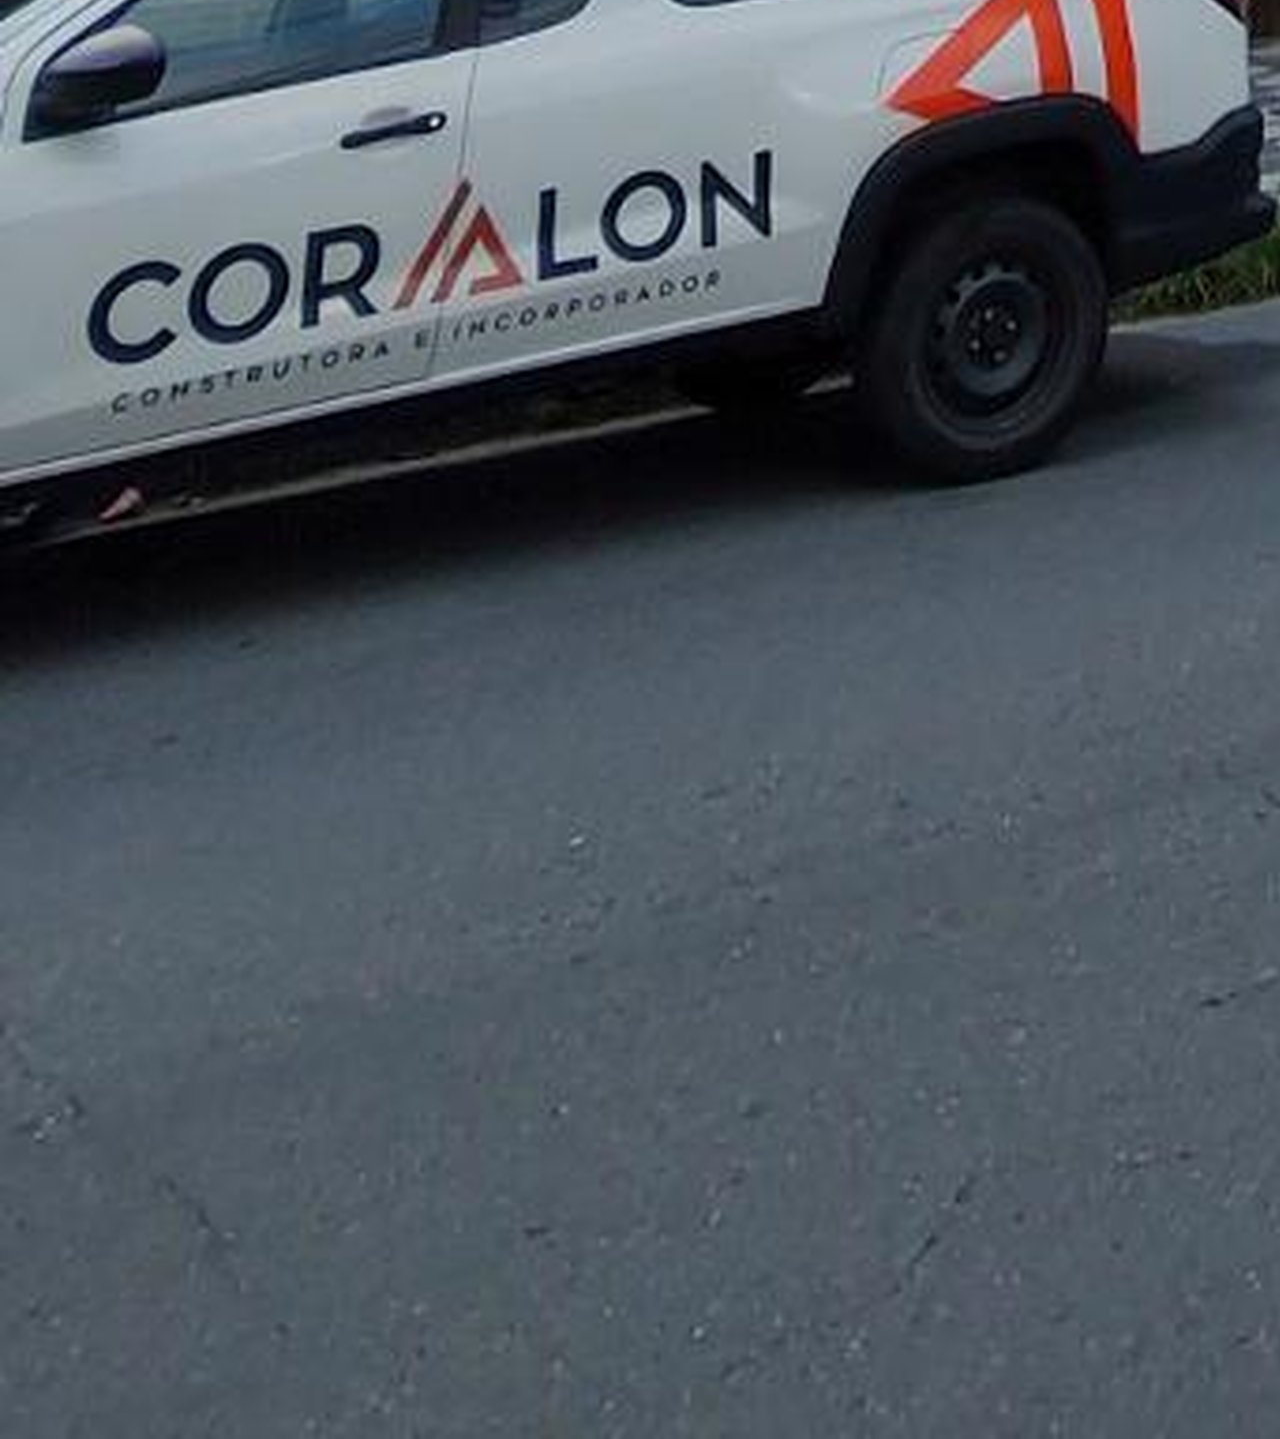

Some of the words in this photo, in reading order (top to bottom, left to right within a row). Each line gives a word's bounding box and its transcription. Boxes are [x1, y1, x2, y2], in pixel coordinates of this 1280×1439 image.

[87, 149, 772, 364] CORALON
[111, 340, 390, 414] CONSTRUTORA
[414, 329, 431, 349] E
